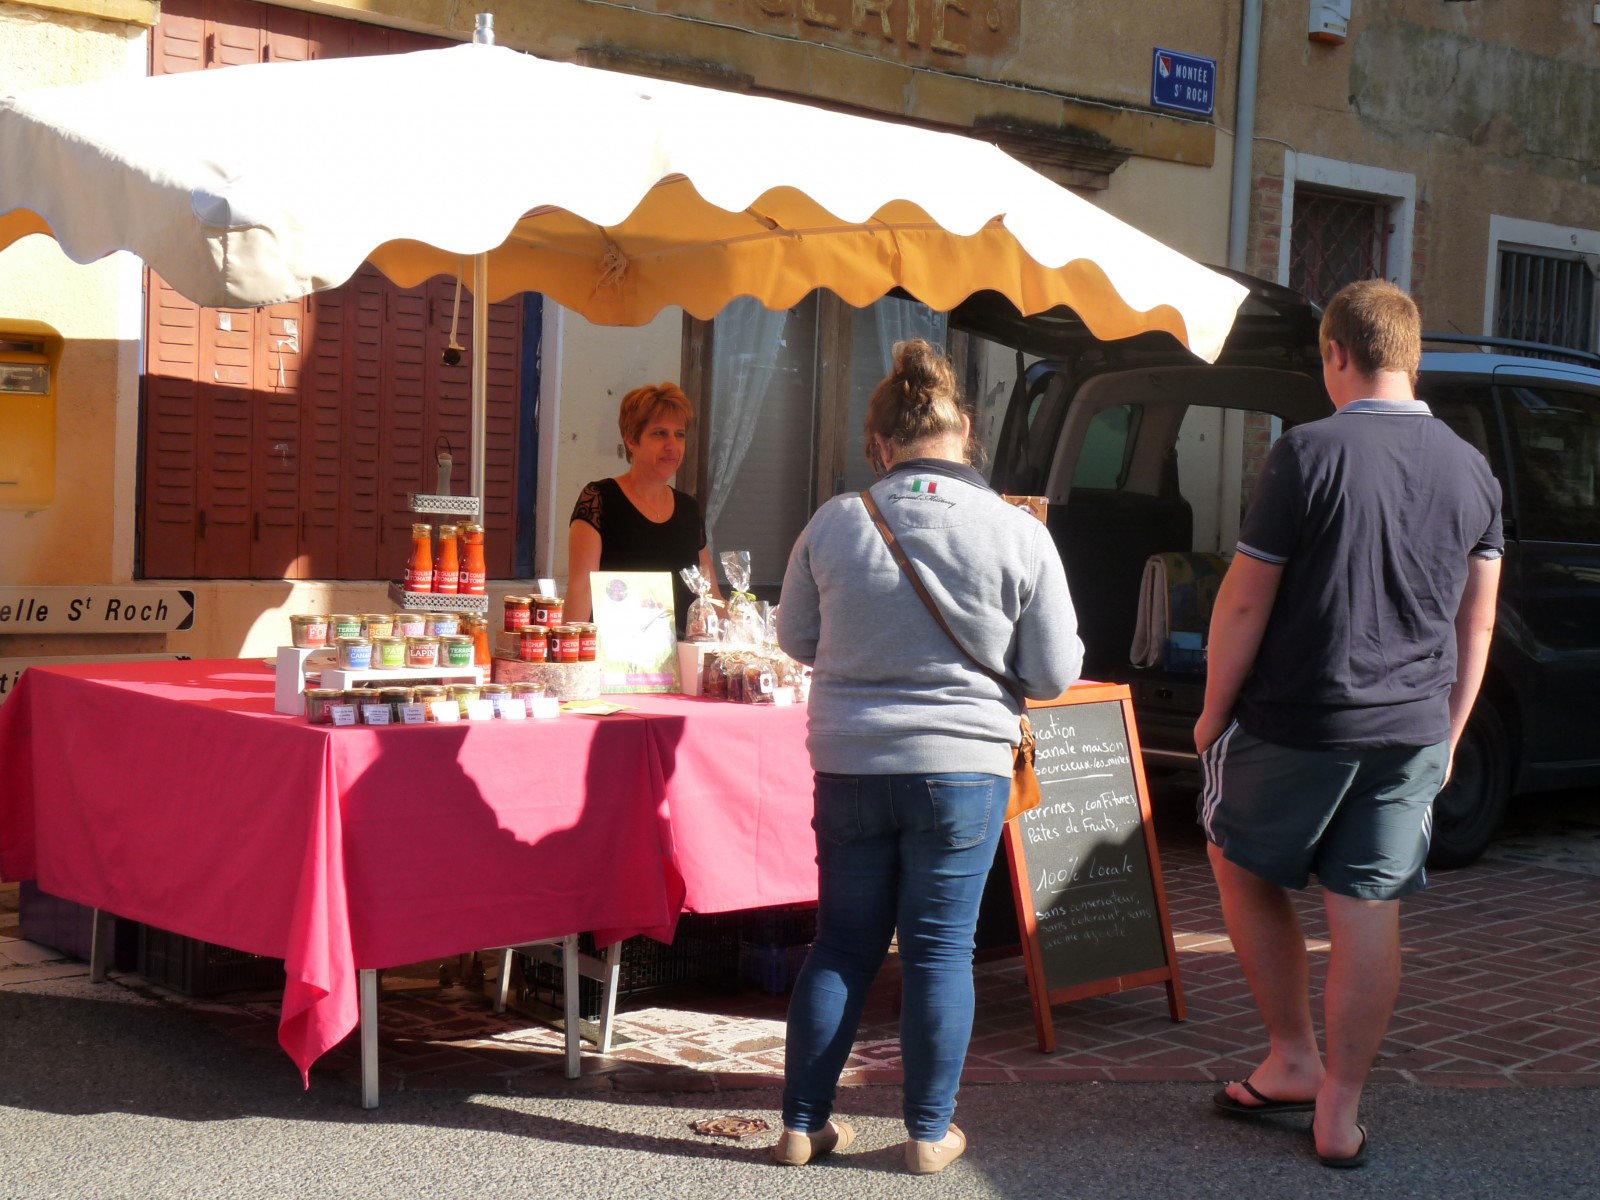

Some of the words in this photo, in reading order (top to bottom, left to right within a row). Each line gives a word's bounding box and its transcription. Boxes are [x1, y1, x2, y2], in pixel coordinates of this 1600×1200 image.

[1186, 86, 1208, 103] ROCH
[68, 597, 91, 622] St
[105, 599, 168, 621] Roch
[411, 649, 435, 657] LAPIN
[1082, 737, 1124, 754] maison
[1065, 817, 1080, 834] de
[1036, 857, 1080, 892] 100%
